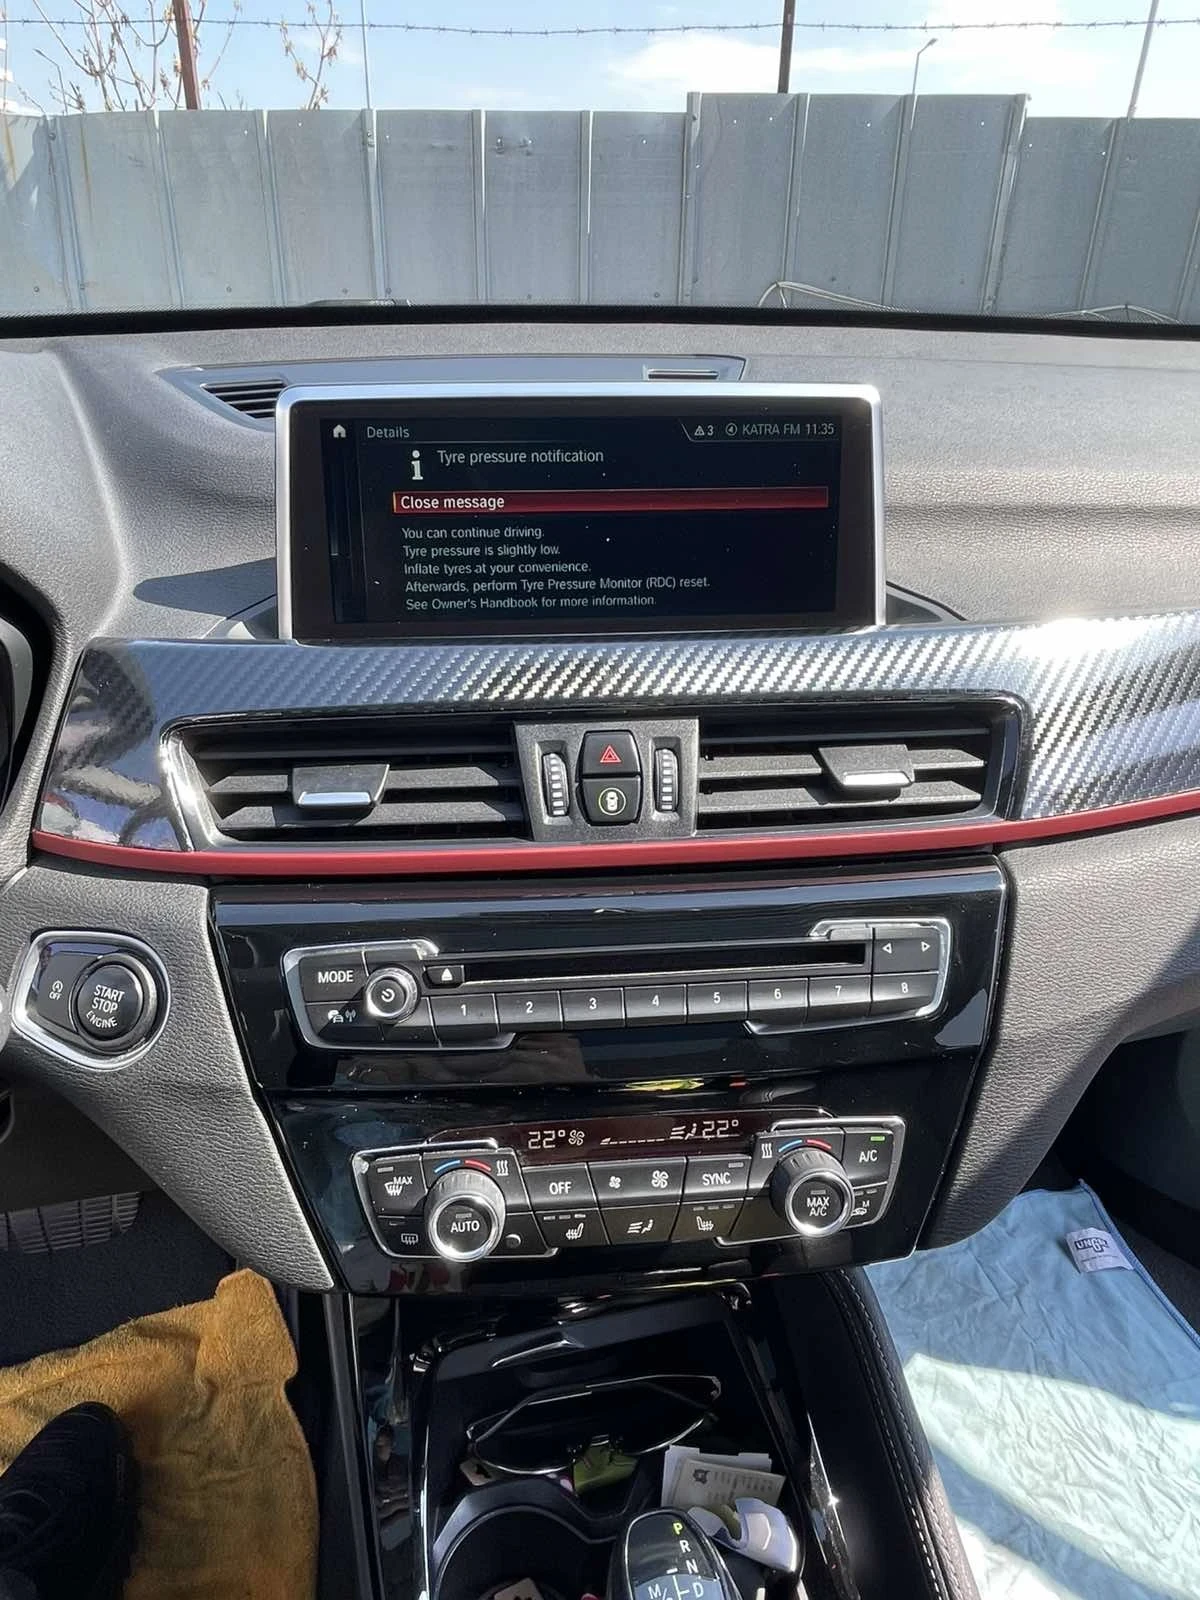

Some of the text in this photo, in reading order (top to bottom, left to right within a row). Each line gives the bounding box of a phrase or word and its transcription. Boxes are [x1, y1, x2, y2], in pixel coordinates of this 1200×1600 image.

[367, 426, 410, 438] Details
[707, 425, 714, 436] 3
[742, 424, 800, 435] KATRA FM
[805, 423, 835, 435] 11:35
[437, 449, 604, 466] Tyre pressure notification
[400, 496, 505, 511] Close message
[402, 526, 545, 540] You can continue driving.
[403, 543, 561, 560] Tyre pressure is slightly low.
[404, 561, 591, 577] Inflate tyres at your convenience.
[405, 575, 710, 594] Afterwards, perform Tyre Pressure Monitor (RDC) reset.
[406, 594, 657, 610] See Owner's Handbook for more information.
[317, 970, 354, 984] MODE
[93, 984, 125, 1003] START
[774, 988, 782, 1000] 6
[834, 985, 842, 997] 7
[901, 982, 909, 994] 8
[49, 991, 61, 1000] OFF
[651, 995, 660, 1007] 4
[713, 992, 721, 1004] 5
[92, 997, 118, 1014] STOP
[460, 1004, 467, 1016] 1
[526, 1001, 534, 1014] 2
[589, 998, 597, 1011] 3
[86, 1010, 118, 1029] ENGINE
[858, 1150, 878, 1163] A/C
[393, 1176, 413, 1186] MAX
[702, 1172, 731, 1186] SYNC
[549, 1181, 572, 1195] OFF
[806, 1197, 830, 1208] MAX
[809, 1206, 827, 1217] A/C
[450, 1220, 480, 1233] AUTO
[672, 1522, 683, 1535] P
[679, 1539, 691, 1553] R
[686, 1558, 699, 1574] N
[692, 1582, 704, 1599] D
